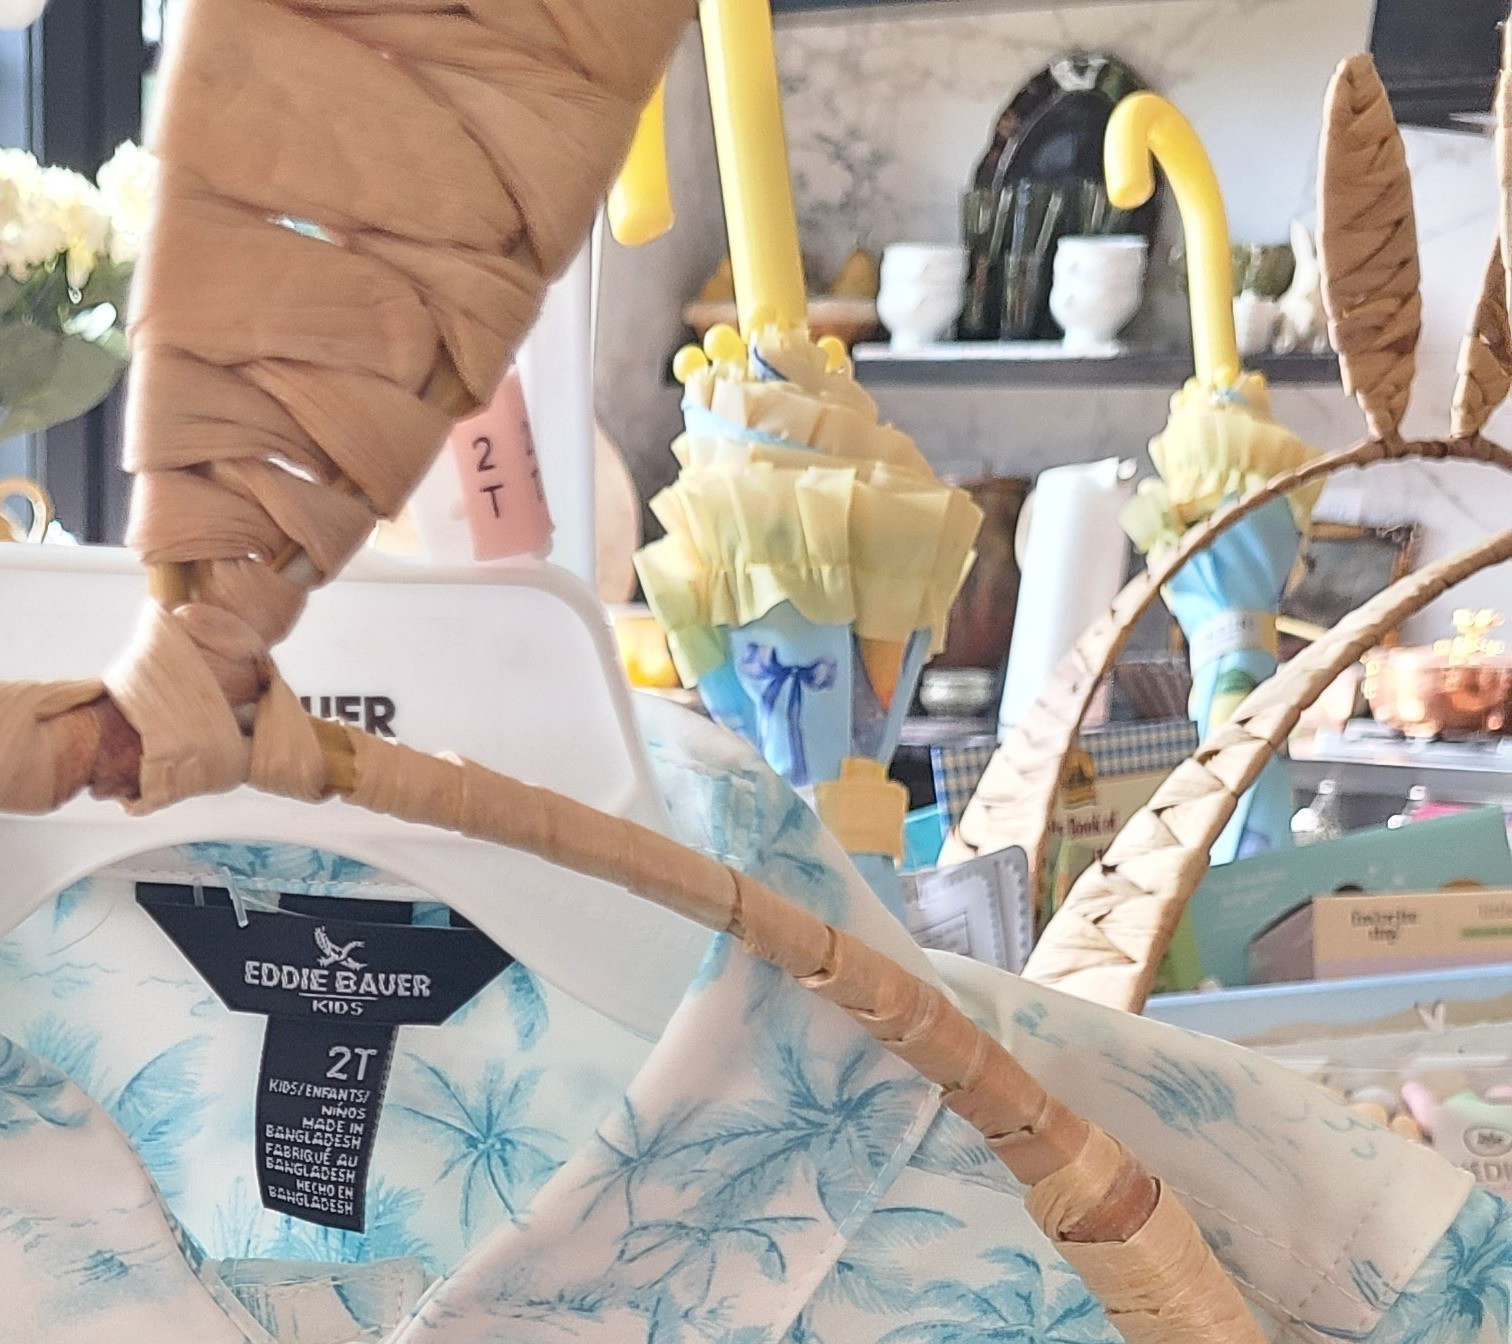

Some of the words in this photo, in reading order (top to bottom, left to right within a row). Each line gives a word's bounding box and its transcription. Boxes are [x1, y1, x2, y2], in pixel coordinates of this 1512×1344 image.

[244, 961, 329, 992] EDDIE
[334, 971, 432, 998] BAUER
[311, 1000, 364, 1016] KIDS
[326, 1046, 378, 1081] 2T
[265, 1124, 361, 1150] BANGLADESH
[302, 1117, 346, 1134] MADE
[349, 1122, 364, 1135] IN
[265, 1157, 356, 1183] BANGLADESH
[337, 1154, 358, 1168] AU
[268, 1185, 354, 1216] BANGLADESH
[296, 1179, 336, 1198] HECHO
[338, 1186, 354, 1200] EN
